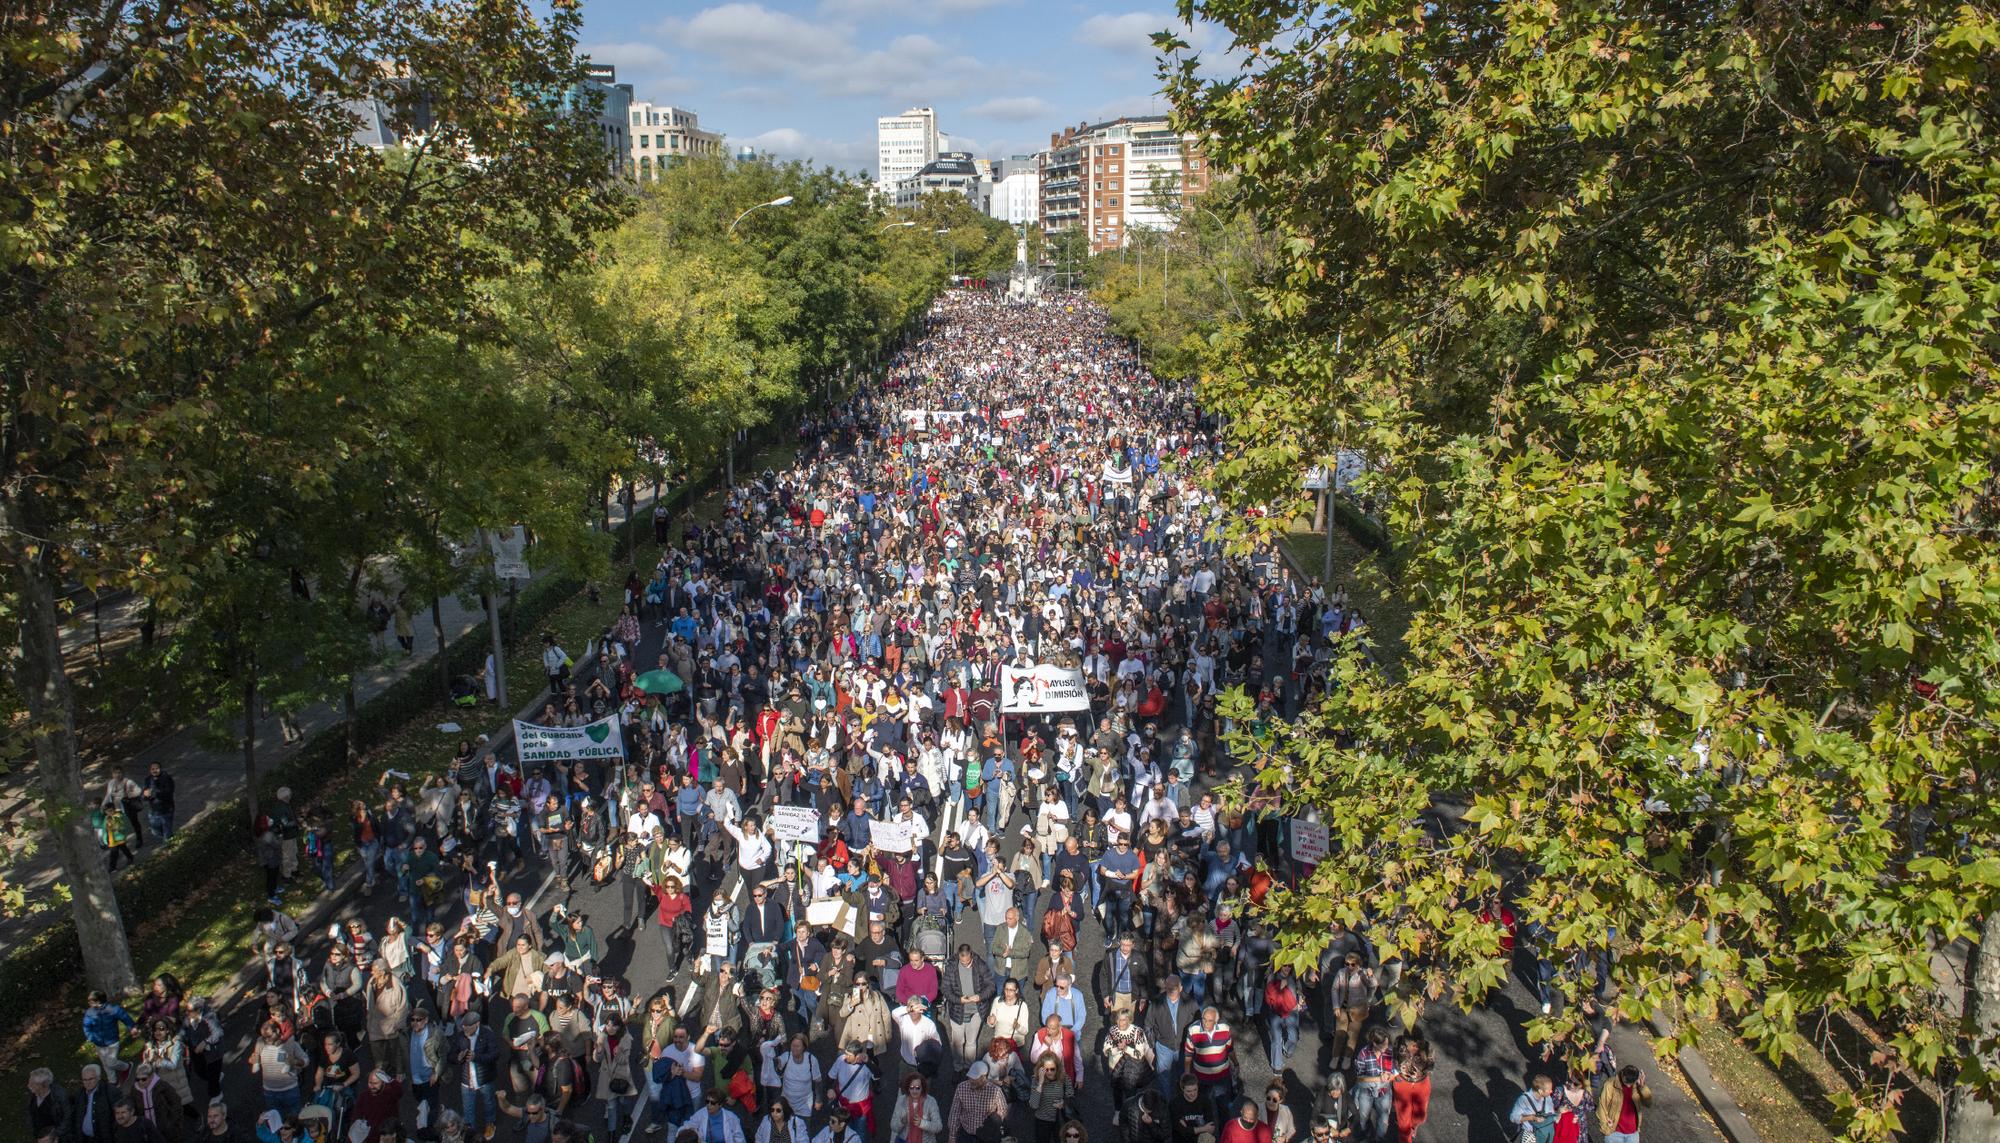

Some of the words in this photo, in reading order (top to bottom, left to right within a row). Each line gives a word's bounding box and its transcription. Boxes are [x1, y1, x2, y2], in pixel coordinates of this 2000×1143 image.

[1049, 680, 1076, 688] AYUSO
[1045, 689, 1083, 699] DIMISIÓN
[522, 730, 538, 740] del
[540, 731, 584, 739] Guadalix
[522, 742, 539, 750] por
[523, 750, 571, 760] SANIDAD
[578, 747, 620, 757] PÚBLICA
